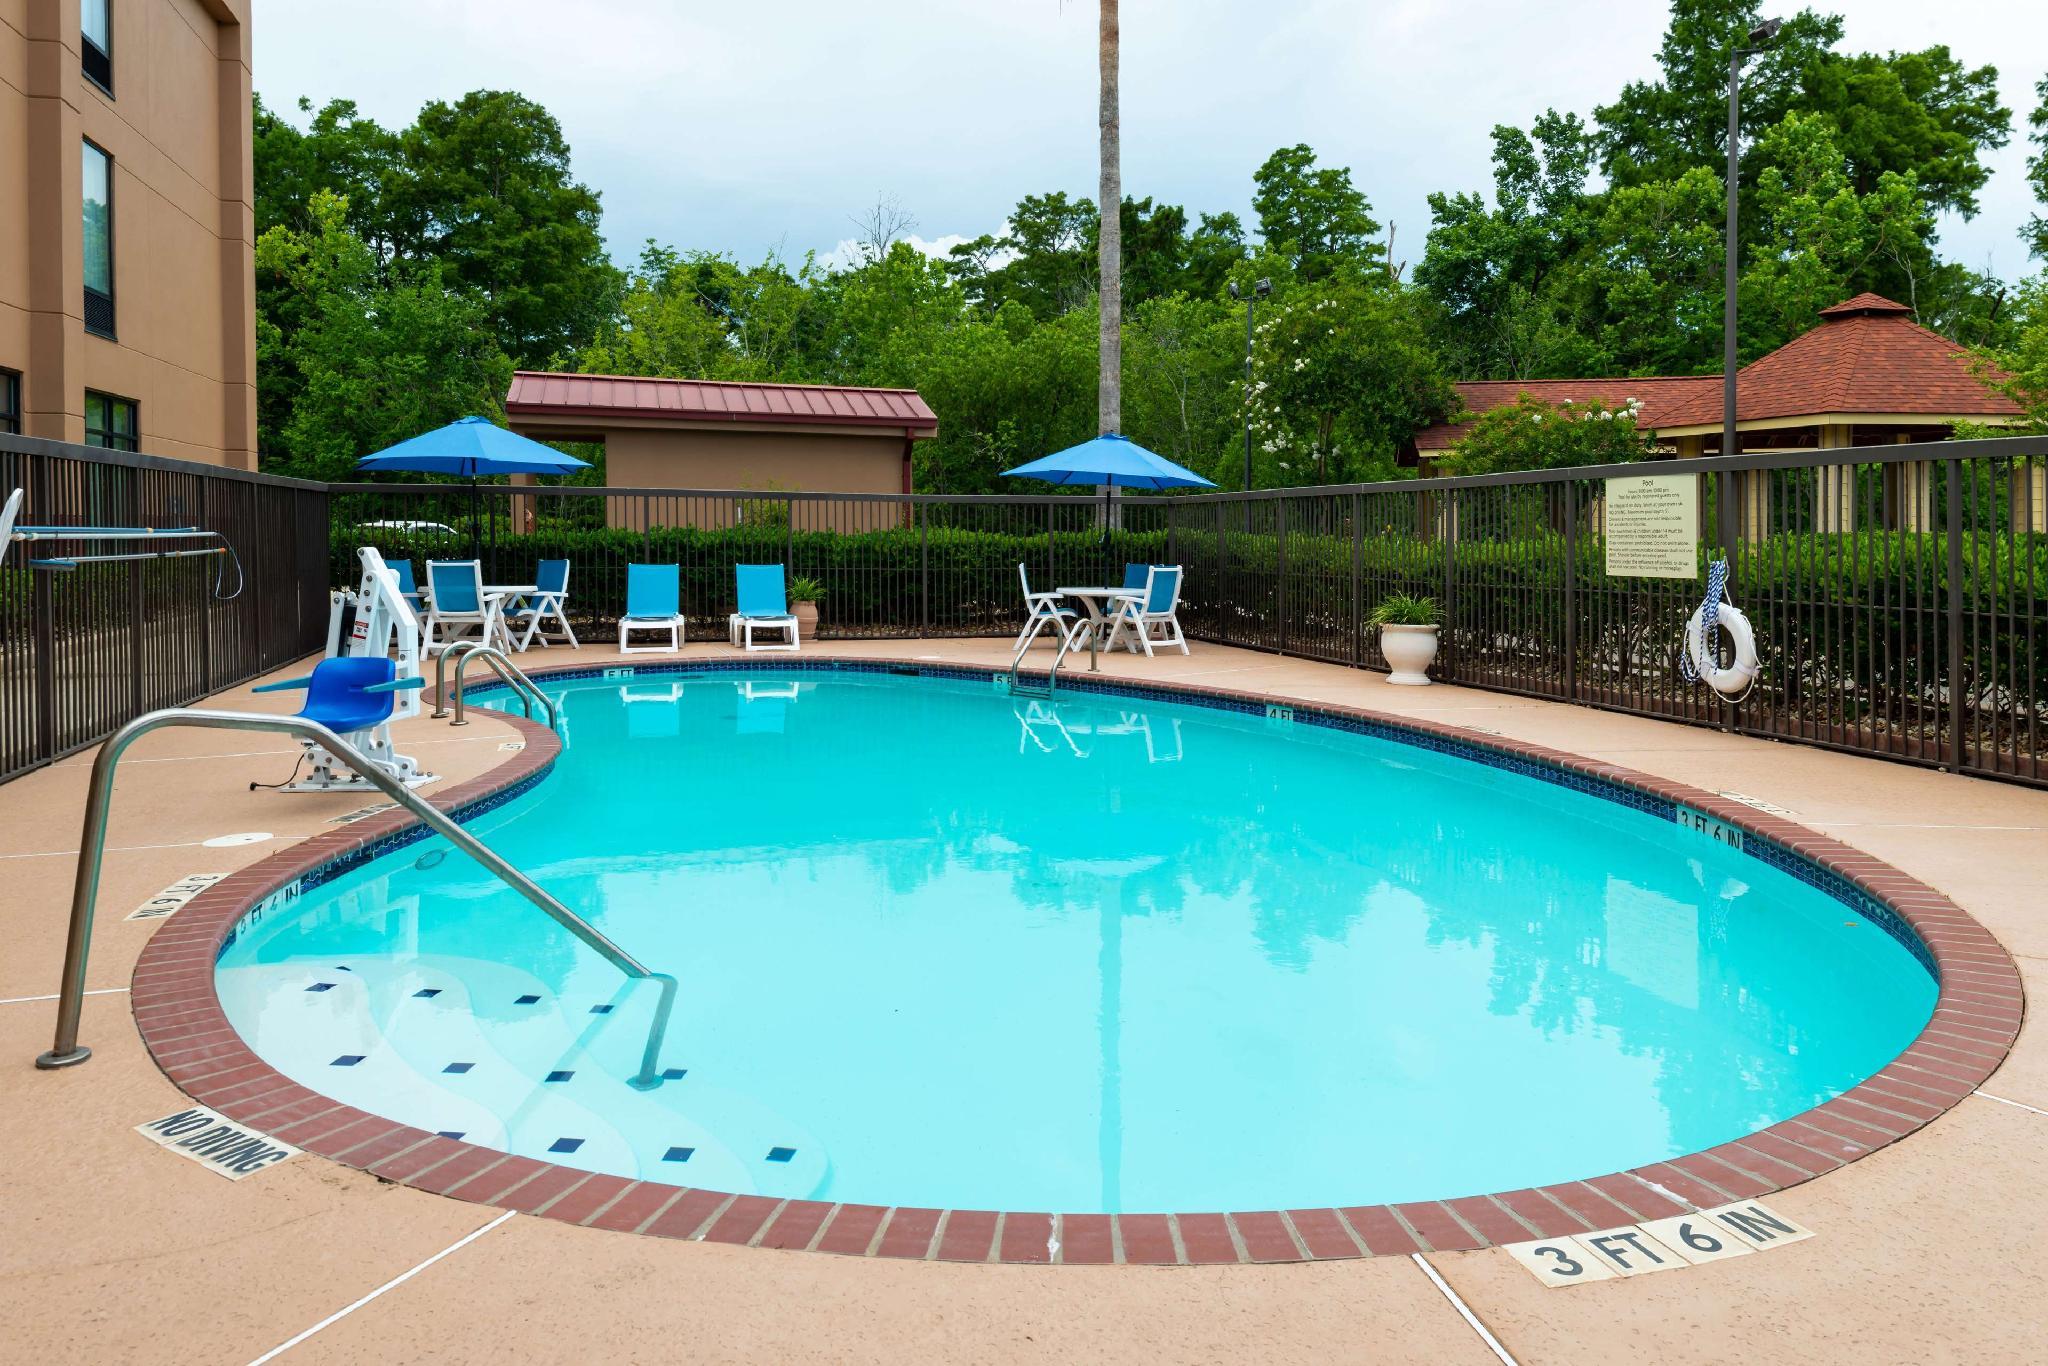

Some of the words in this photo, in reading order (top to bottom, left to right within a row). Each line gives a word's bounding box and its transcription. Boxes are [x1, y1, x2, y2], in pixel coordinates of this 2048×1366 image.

[1269, 708, 1277, 719] 4
[1281, 709, 1292, 720] FT
[1682, 810, 1689, 827] 3
[1695, 814, 1708, 834] FT
[1713, 824, 1721, 841] 6
[1727, 828, 1740, 849] IN
[251, 903, 263, 926] FT
[285, 883, 299, 903] IN
[146, 1109, 215, 1137] NO
[175, 1125, 289, 1173] DIVING
[1534, 1246, 1584, 1276] 3
[1588, 1232, 1665, 1269] FT
[1679, 1223, 1723, 1252] 6
[1717, 1206, 1798, 1243] IN
